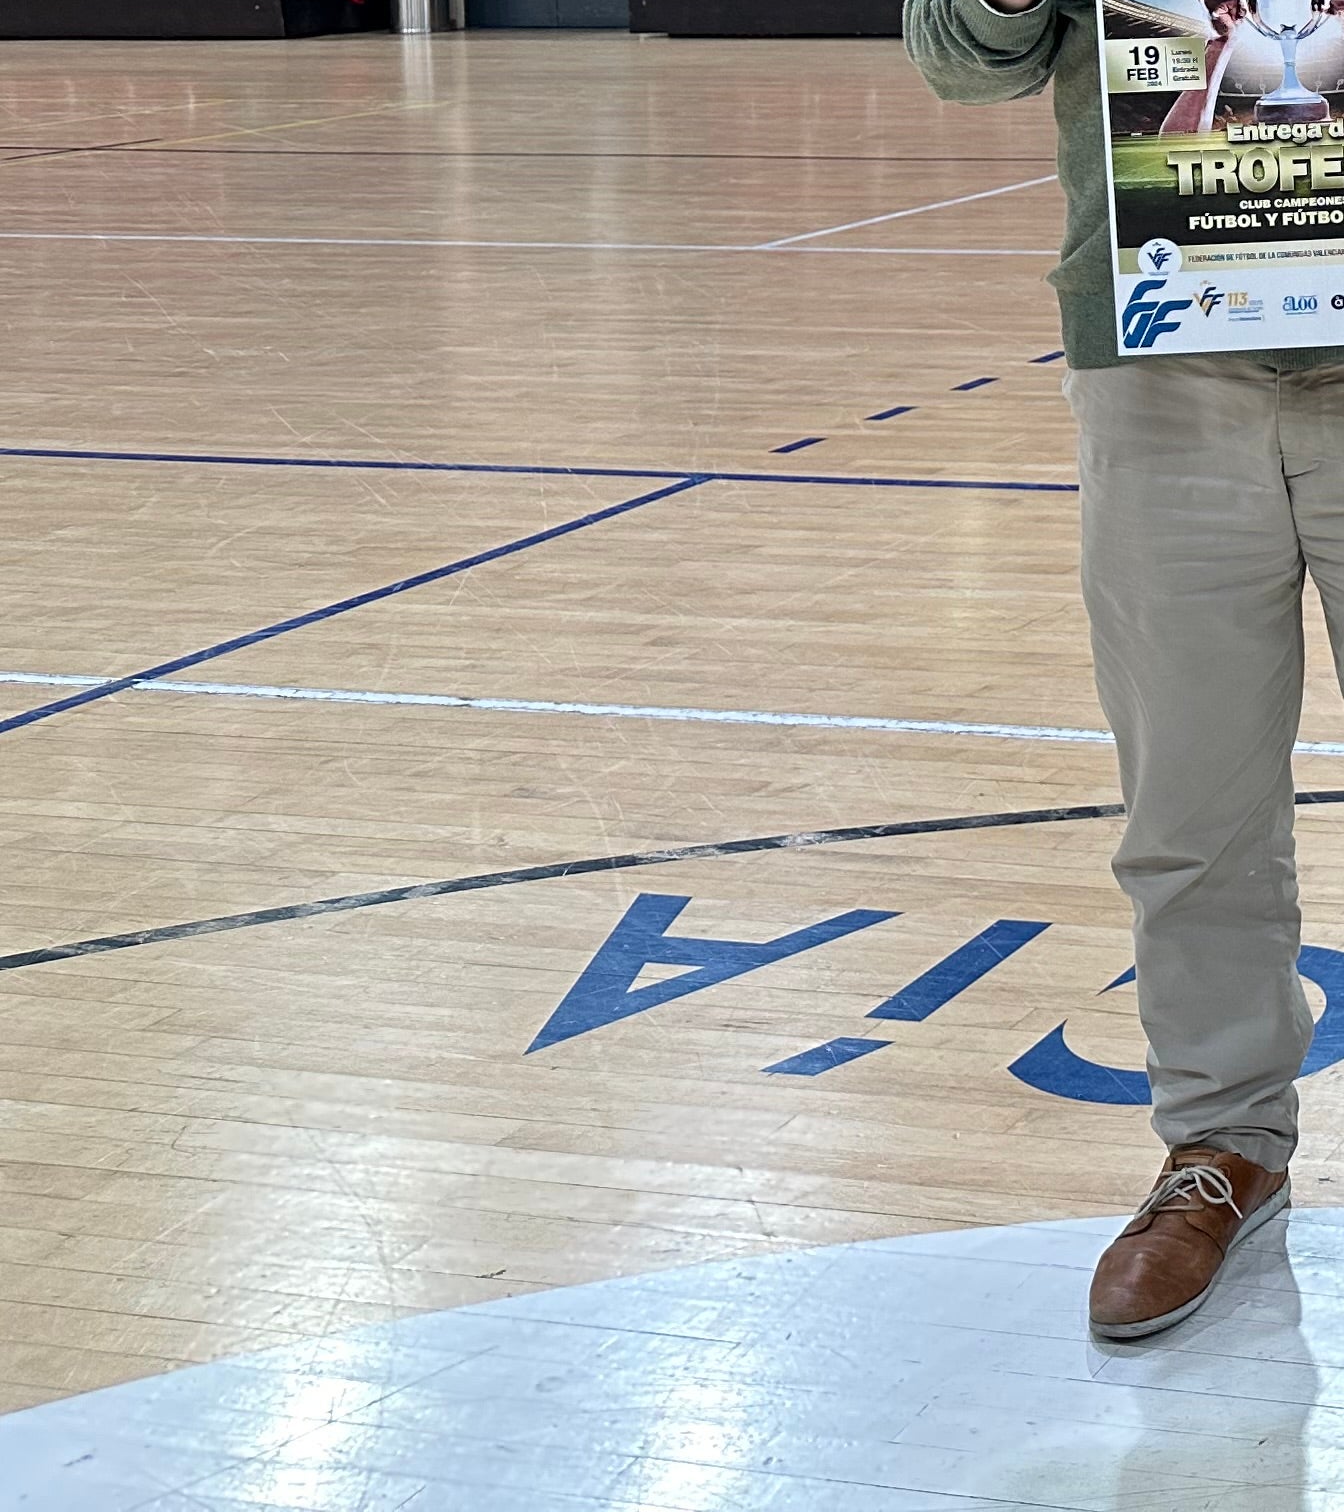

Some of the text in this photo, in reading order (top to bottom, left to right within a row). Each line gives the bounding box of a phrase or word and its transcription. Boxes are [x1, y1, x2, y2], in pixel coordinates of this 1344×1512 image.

[1128, 45, 1160, 65] 19
[1126, 68, 1159, 81] FEB
[1227, 121, 1323, 144] Entrega
[1239, 198, 1271, 209] CLUB
[1189, 212, 1261, 230] FÚTBOL
[1264, 213, 1279, 226] Y
[1227, 292, 1248, 306] 113
